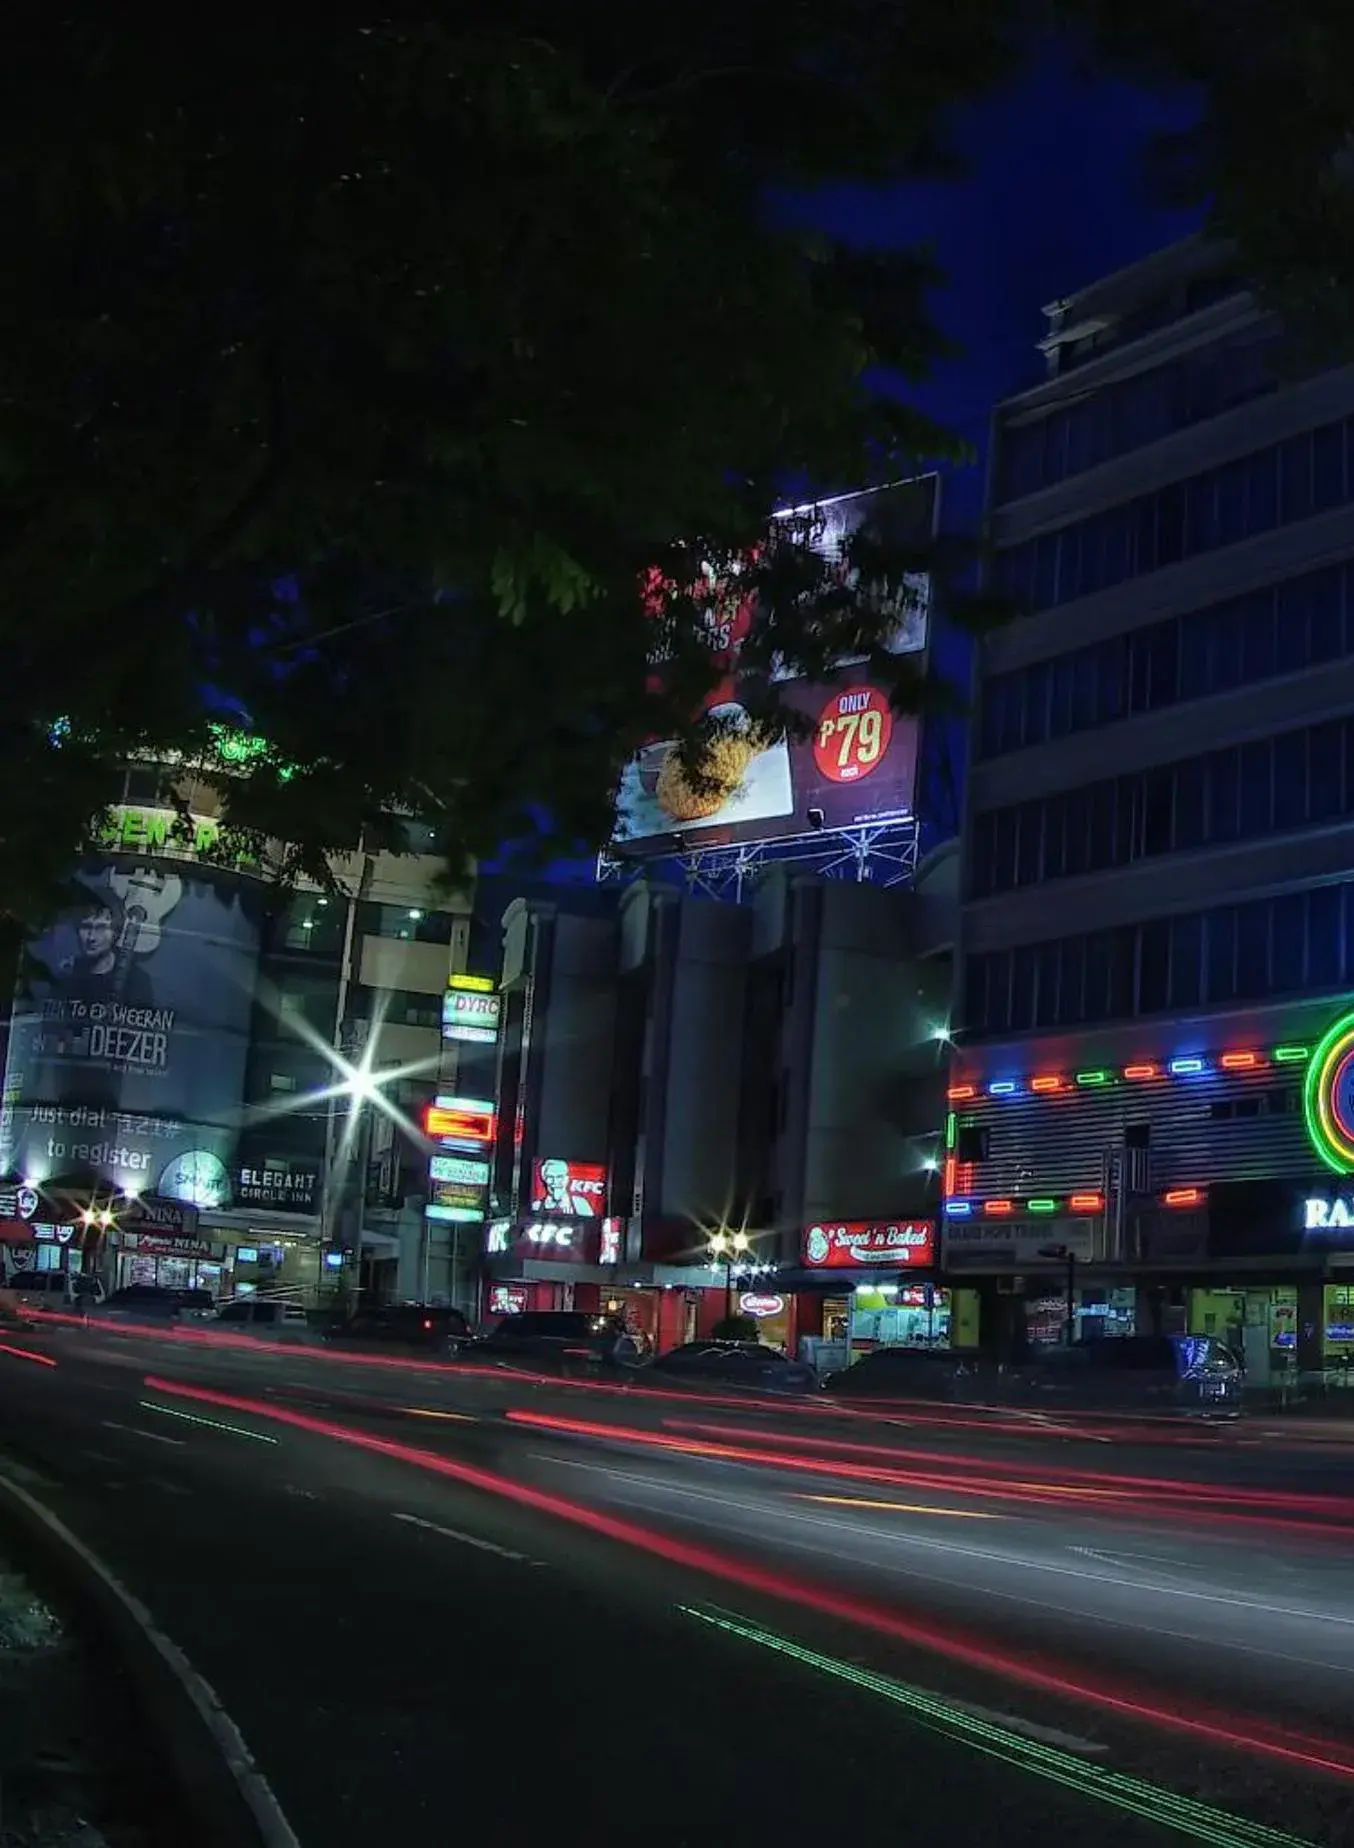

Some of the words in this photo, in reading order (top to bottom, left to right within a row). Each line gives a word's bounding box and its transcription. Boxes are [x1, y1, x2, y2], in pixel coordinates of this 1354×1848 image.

[839, 692, 871, 714] ONLY
[112, 1003, 175, 1031] SHEERAN
[89, 1024, 168, 1067] DEEZER
[70, 1105, 105, 1128] dial
[48, 1138, 66, 1158] to
[71, 1141, 152, 1169] register
[174, 1171, 222, 1191] SMRT
[241, 1168, 316, 1190] ELEGANT
[570, 1179, 605, 1195] KFC
[528, 1223, 573, 1246] KFC
